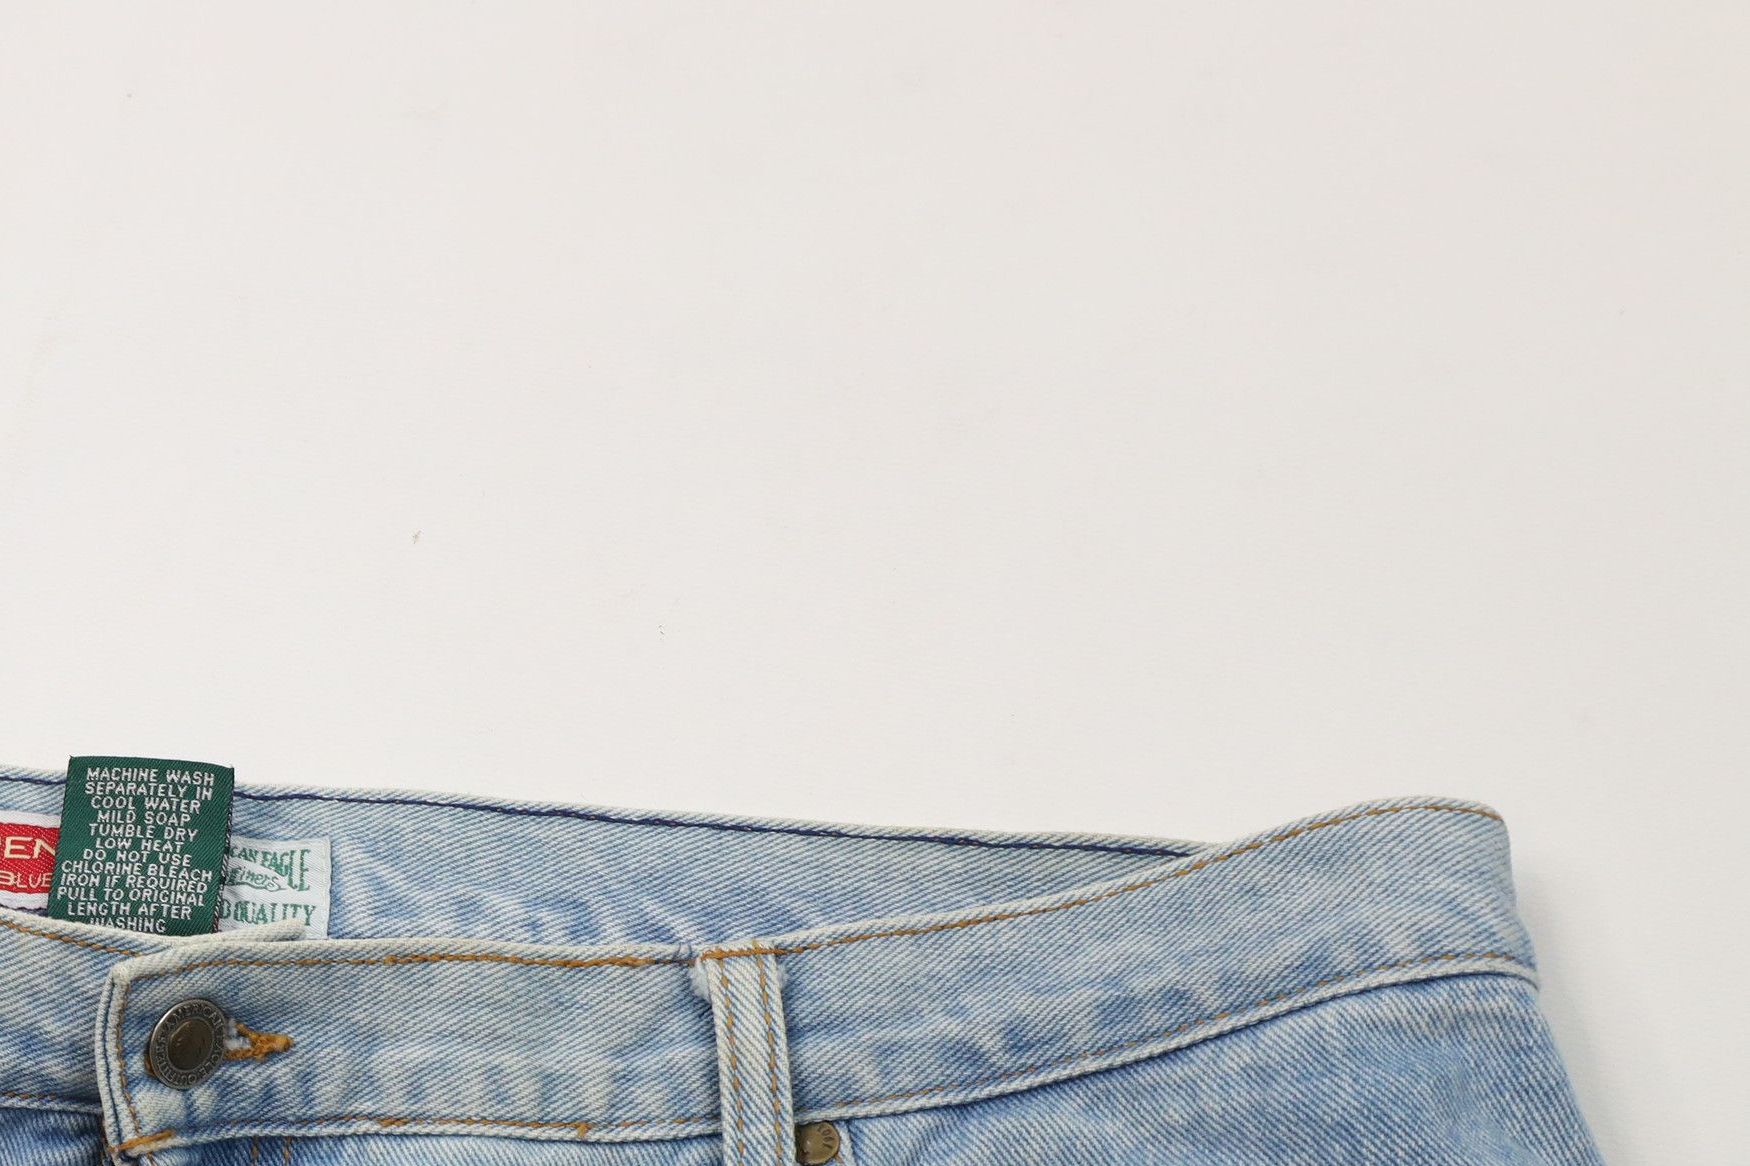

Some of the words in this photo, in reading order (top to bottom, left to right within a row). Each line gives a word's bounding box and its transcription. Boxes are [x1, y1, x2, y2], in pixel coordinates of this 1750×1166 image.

[87, 768, 158, 782] MACHINE
[166, 770, 215, 786] WASH
[85, 782, 188, 797] SEPARATELY
[197, 788, 213, 800] IN
[91, 796, 135, 810] COOL
[144, 798, 200, 814] WATER
[97, 810, 136, 824] MILD
[144, 812, 190, 826] SOAP
[89, 824, 155, 838] TUMBLE
[164, 828, 198, 841] DRY
[96, 838, 132, 850] LOW
[141, 840, 184, 853] HEAT
[84, 849, 107, 860] DO
[116, 851, 150, 862] NOT
[159, 855, 192, 866] USE
[62, 861, 142, 876] CHLORINE
[148, 865, 213, 882] BLEACH
[61, 874, 99, 887] IRON
[105, 876, 120, 887] IF
[126, 877, 208, 893] REQUIRED
[57, 887, 98, 900] PULL
[104, 889, 124, 900] TO
[129, 890, 204, 907] ORIGINAL
[68, 902, 130, 916] LENGTH
[138, 904, 191, 920] AFTER
